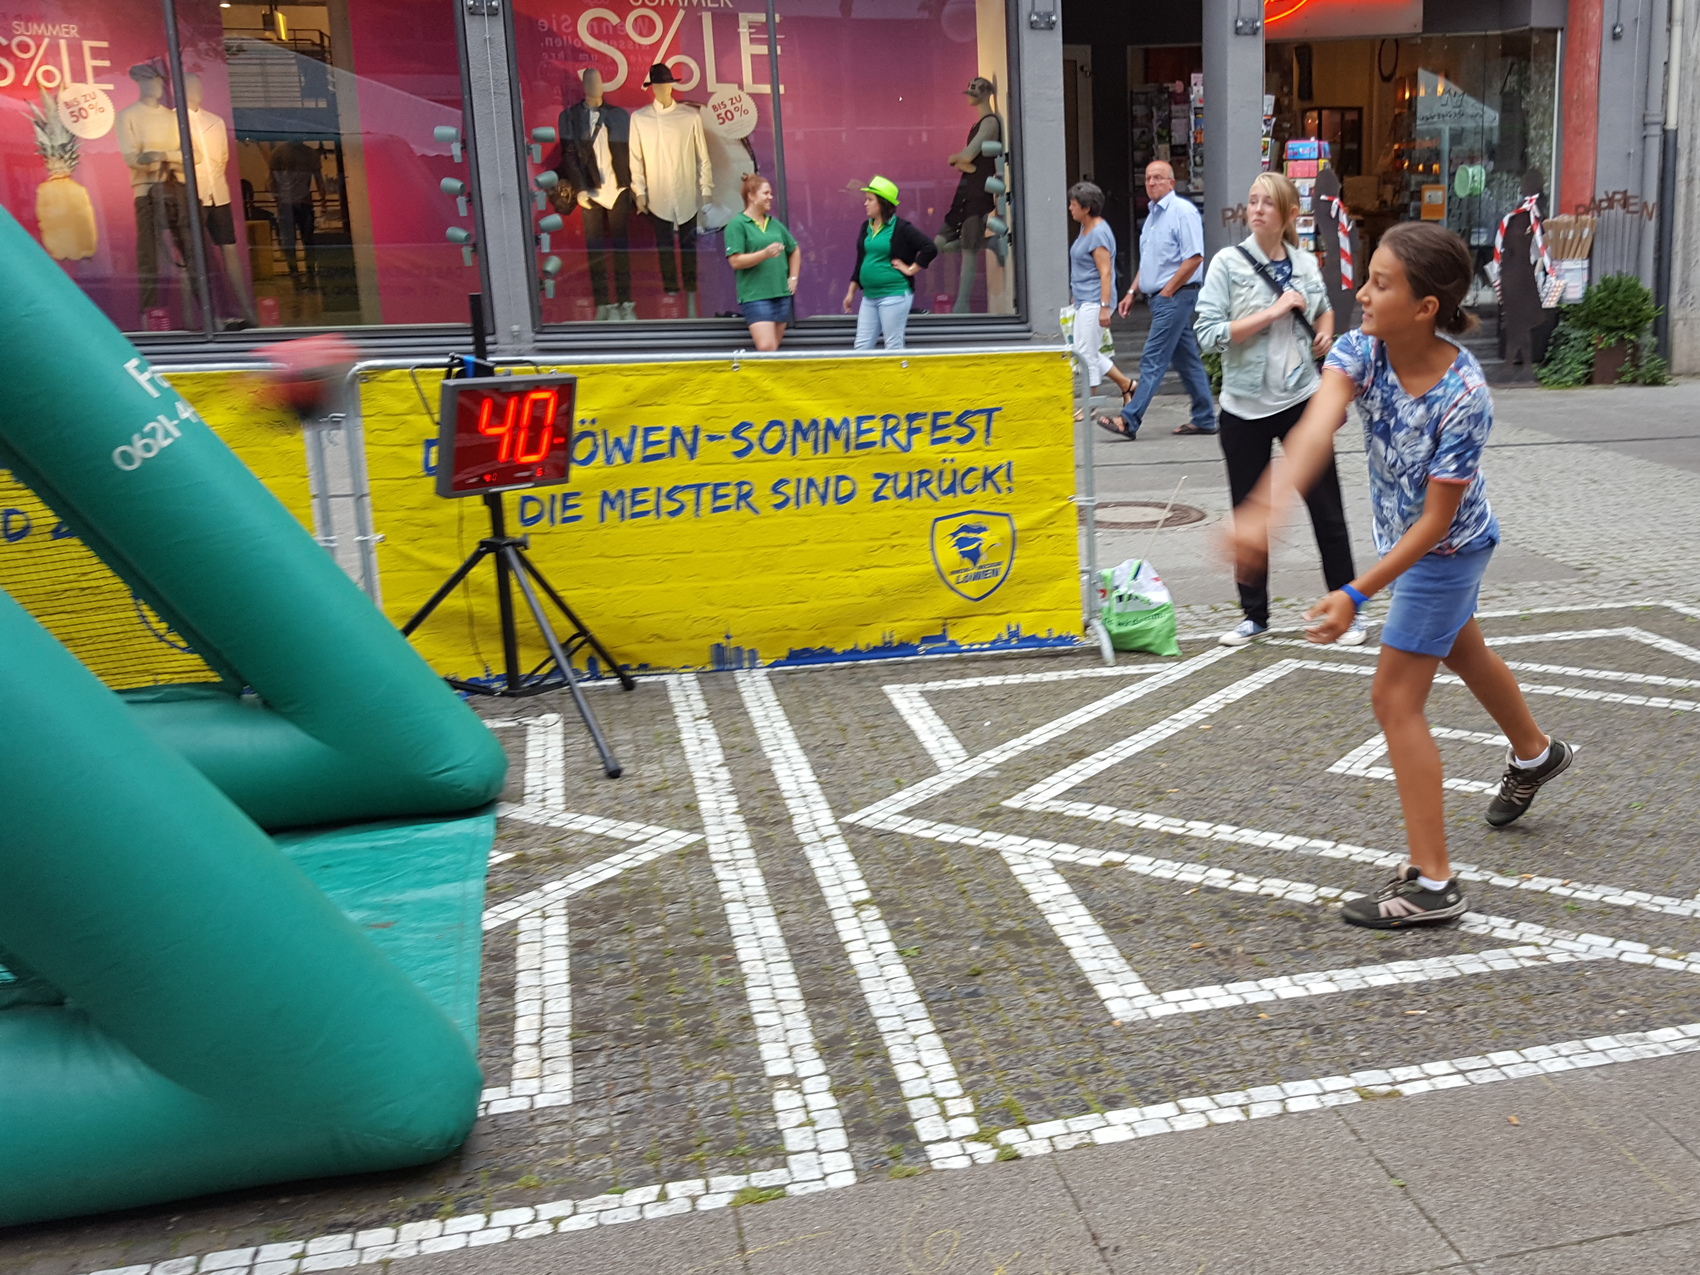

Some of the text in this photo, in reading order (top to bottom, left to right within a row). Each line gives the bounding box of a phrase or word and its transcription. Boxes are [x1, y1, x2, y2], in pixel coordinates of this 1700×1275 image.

[12, 21, 80, 38] SUMMER
[63, 91, 97, 110] BIS ZU
[711, 94, 742, 113] BIS ZU
[716, 103, 750, 126] 50%
[477, 389, 559, 465] 40
[570, 405, 1003, 467] ÖWEN-SOMMERFEST
[519, 457, 1015, 528] DIE MEISTER SIND ZURÜCK!
